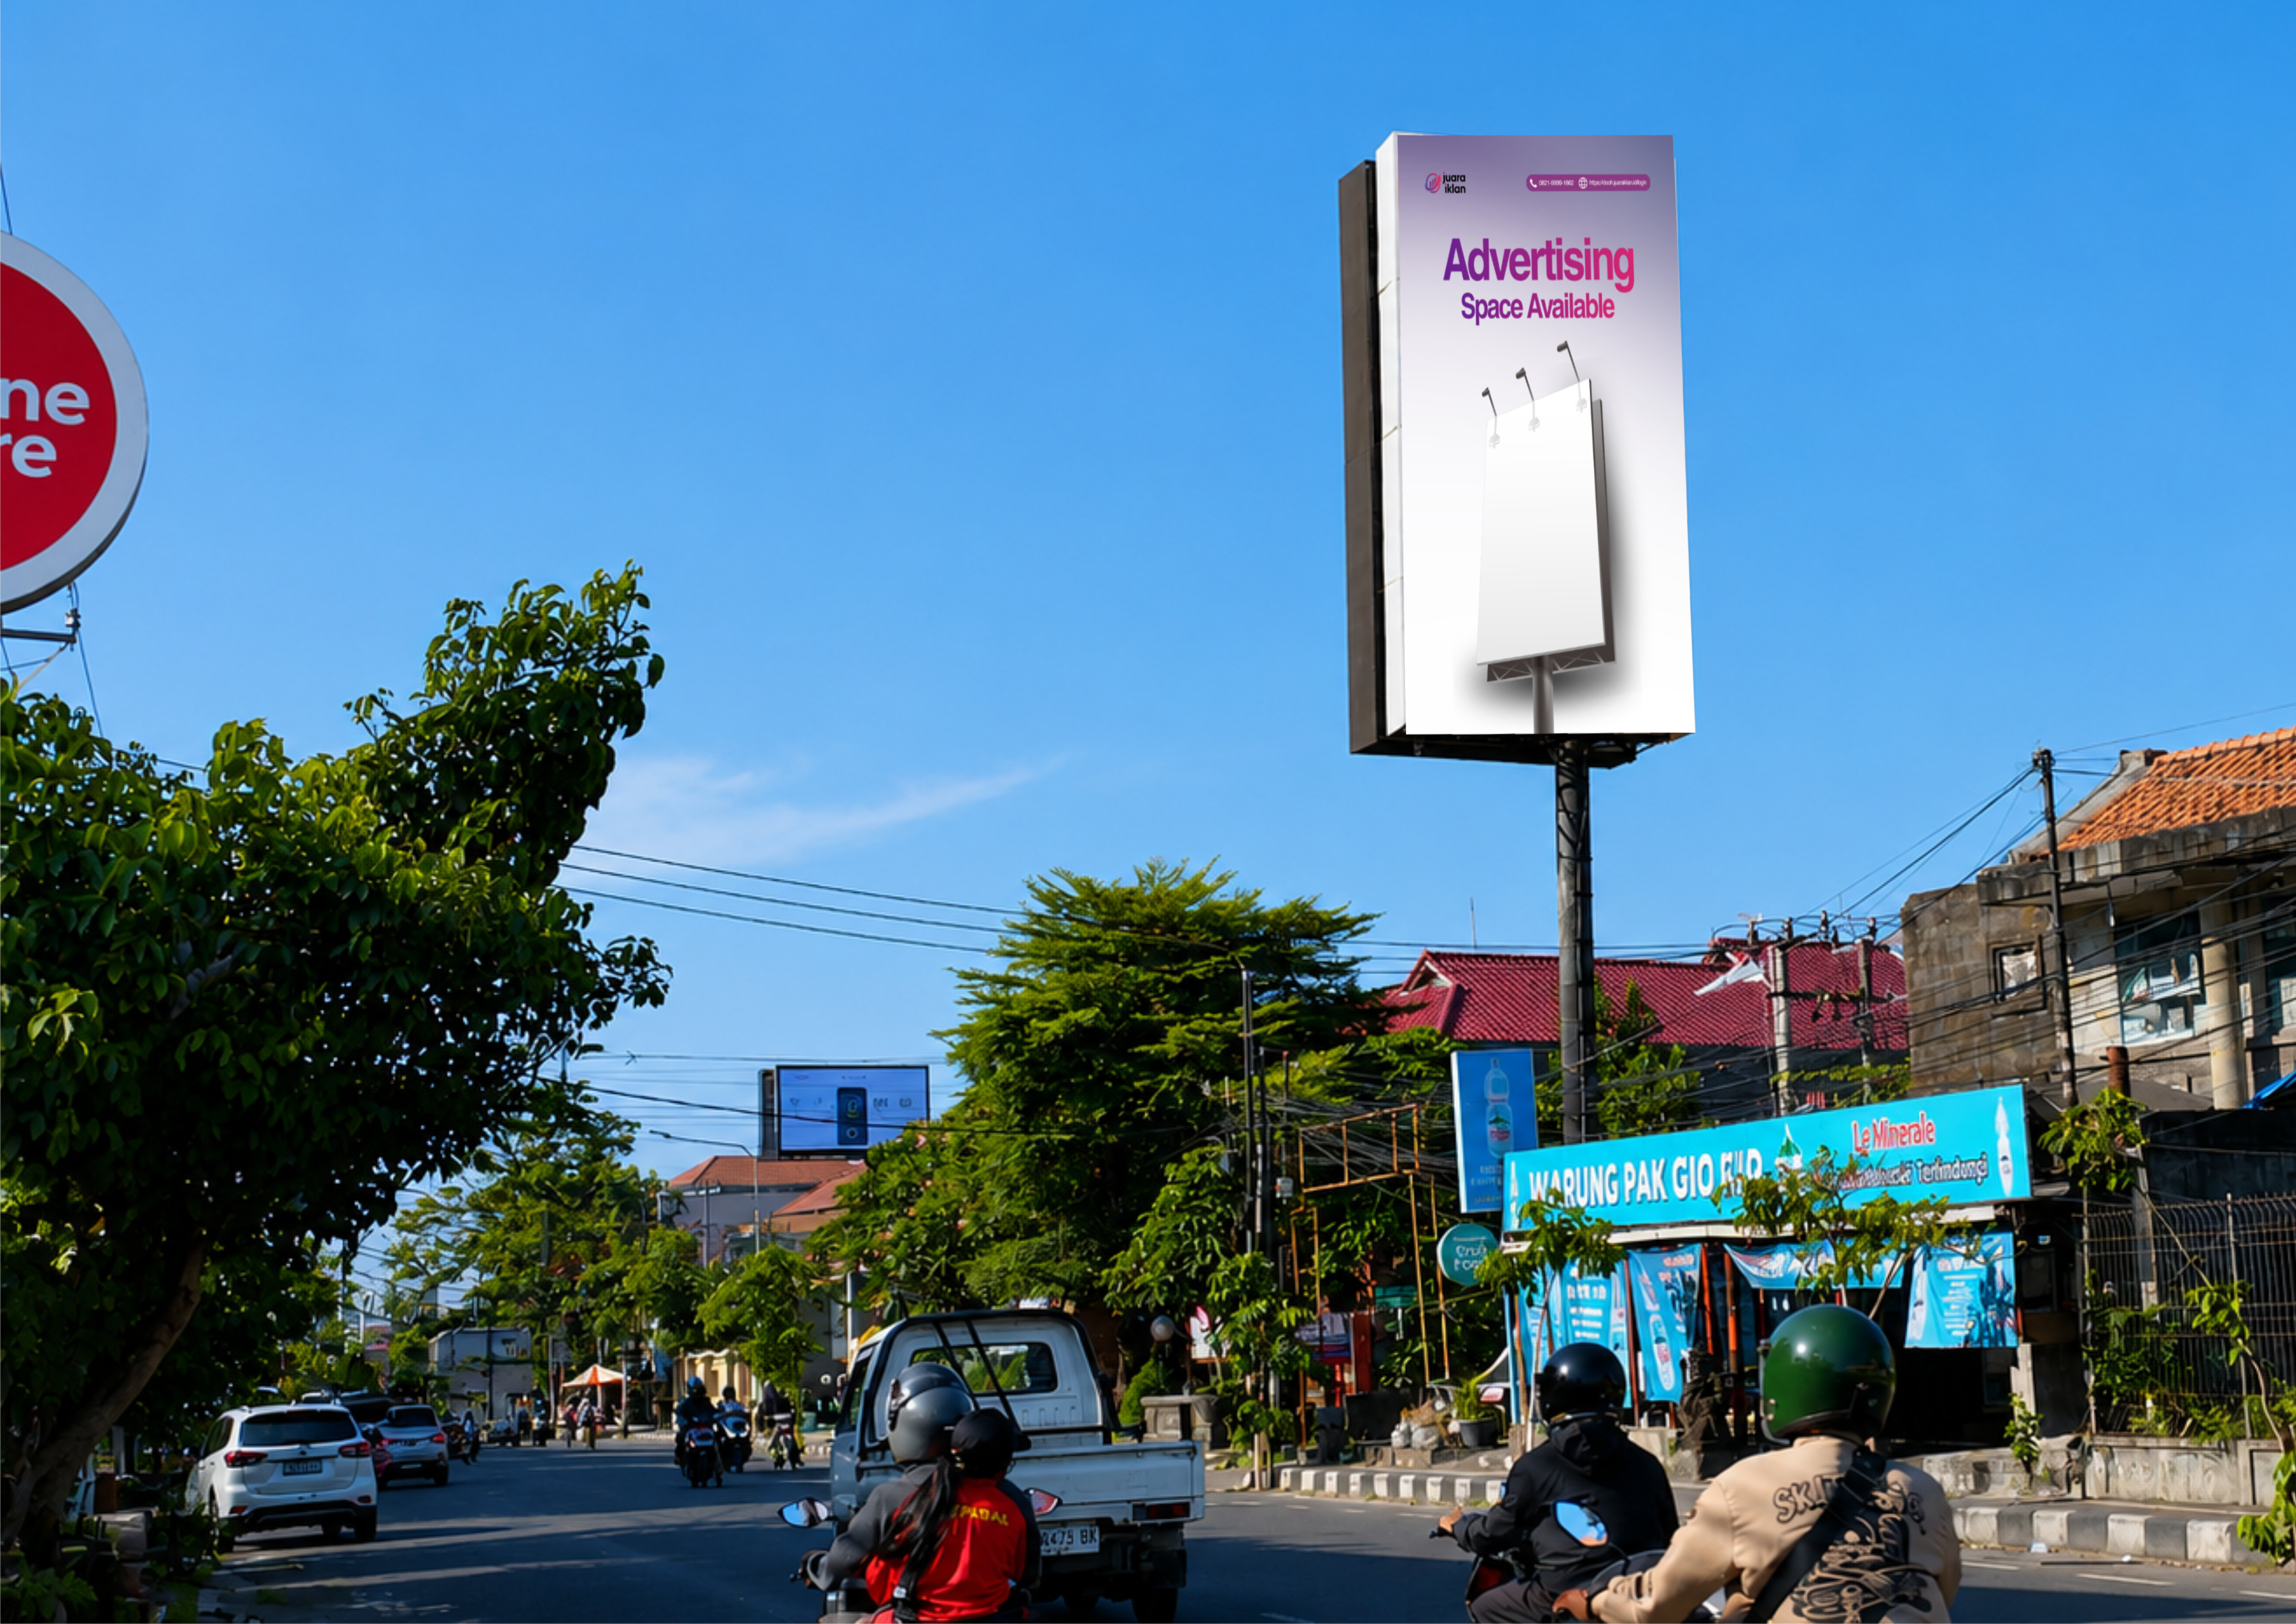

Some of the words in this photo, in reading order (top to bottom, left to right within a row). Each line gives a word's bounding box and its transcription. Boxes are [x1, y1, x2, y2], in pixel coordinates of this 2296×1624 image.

[1443, 172, 1466, 184] juara
[1445, 183, 1466, 194] iklan
[1443, 237, 1635, 293] Advertising
[1461, 293, 1523, 325] Space
[1527, 293, 1615, 319] Available
[1852, 1120, 1871, 1153] Le
[1872, 1110, 1936, 1149] Minerale
[1529, 1163, 1618, 1208] WARUNG
[1624, 1159, 1668, 1204] PAK
[1672, 1154, 1714, 1200] GIO
